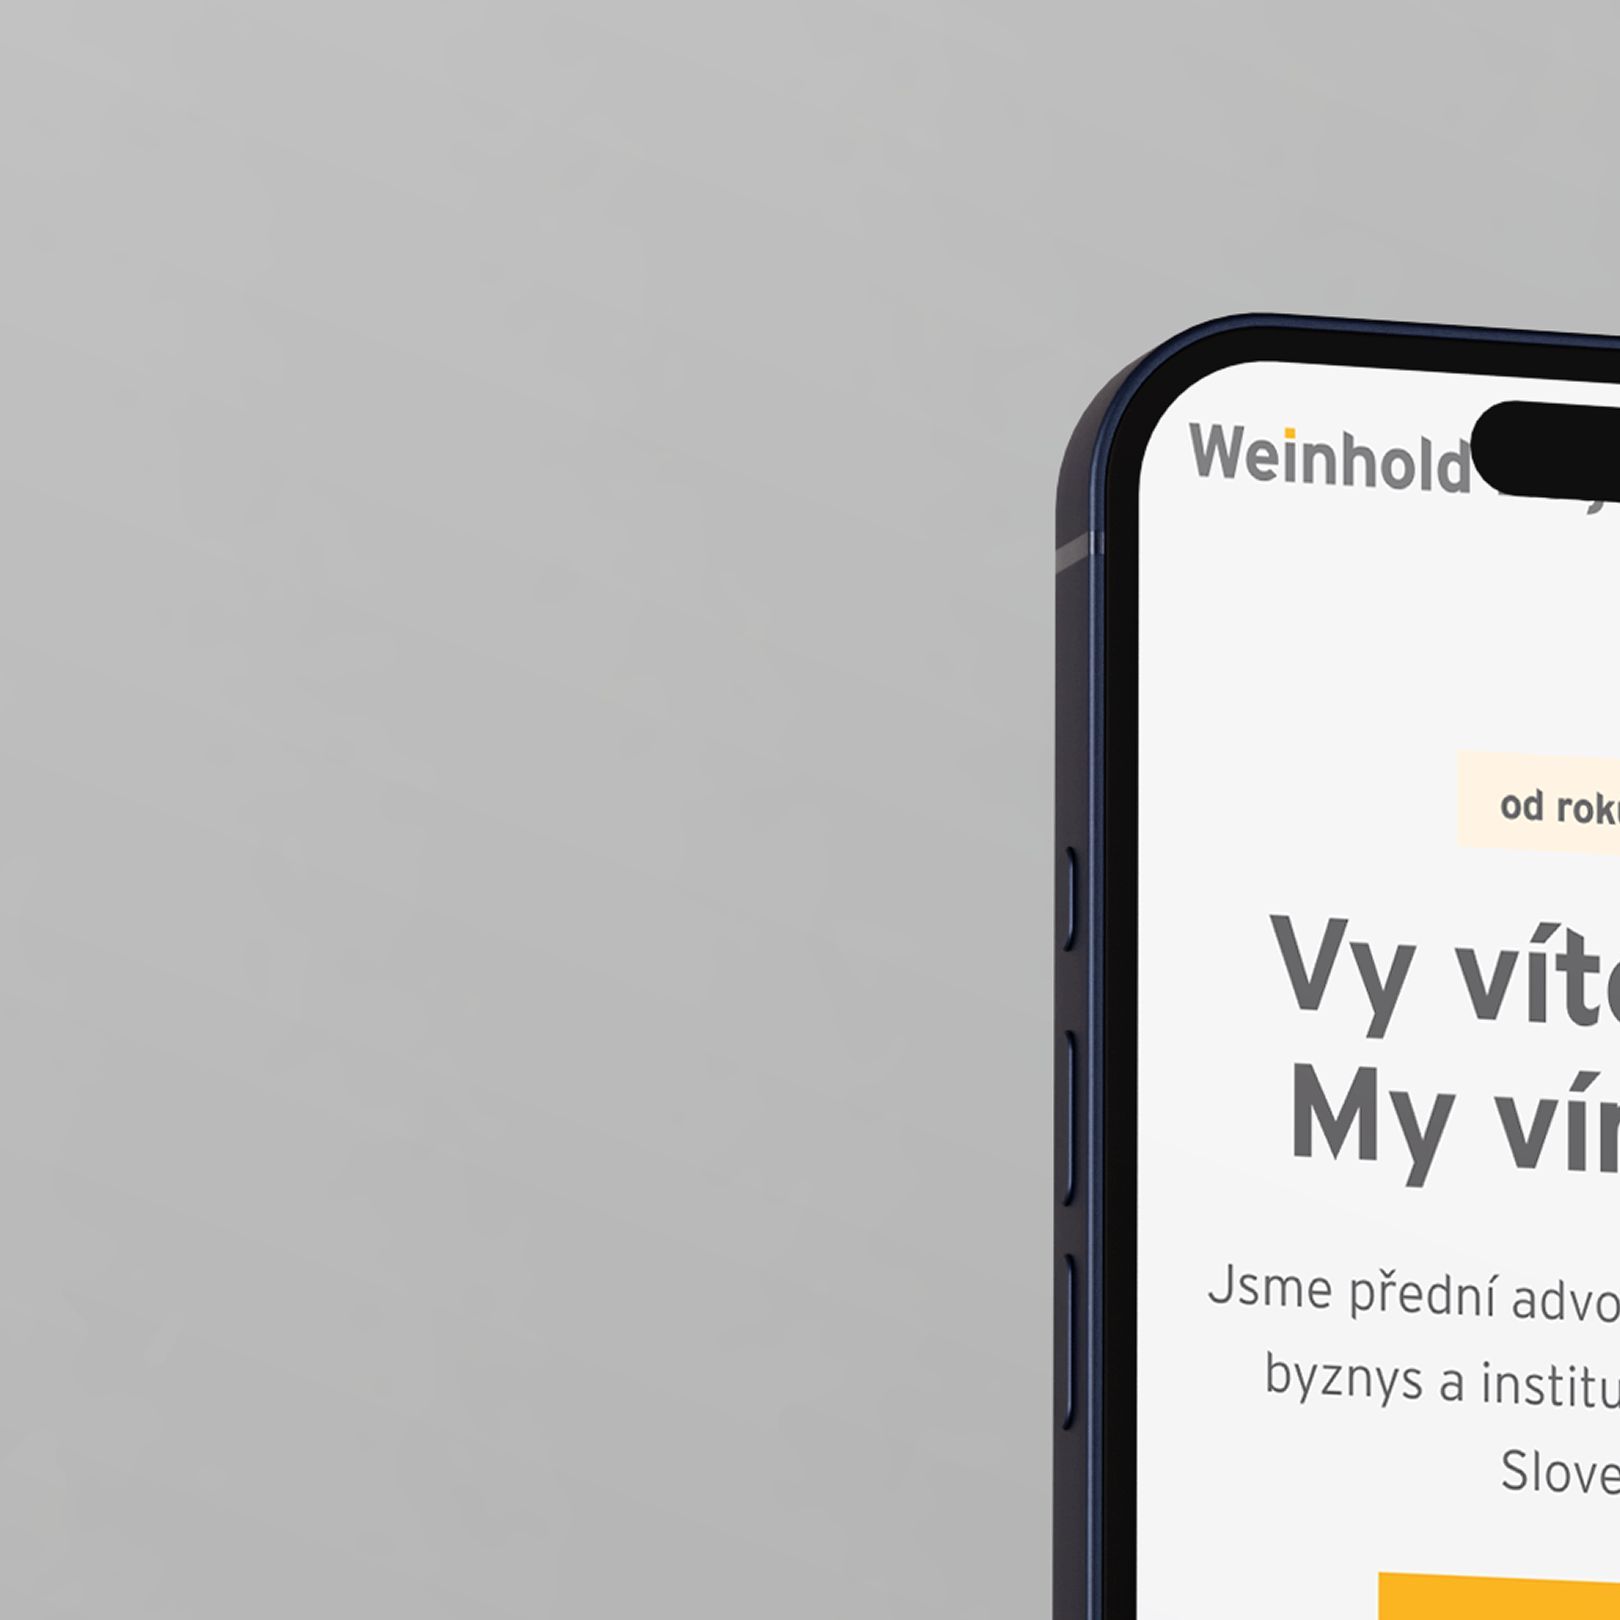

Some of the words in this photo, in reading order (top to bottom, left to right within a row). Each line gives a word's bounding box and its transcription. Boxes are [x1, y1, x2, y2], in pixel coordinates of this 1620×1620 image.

[1189, 422, 1472, 495] Weinhold
[1500, 788, 1544, 821] od
[1269, 914, 1417, 1040] Vy
[1293, 1062, 1457, 1189] My
[1207, 1263, 1332, 1309] Jsme
[1351, 1268, 1500, 1320] přední
[1267, 1350, 1423, 1409] byznys
[1440, 1369, 1463, 1402] a
